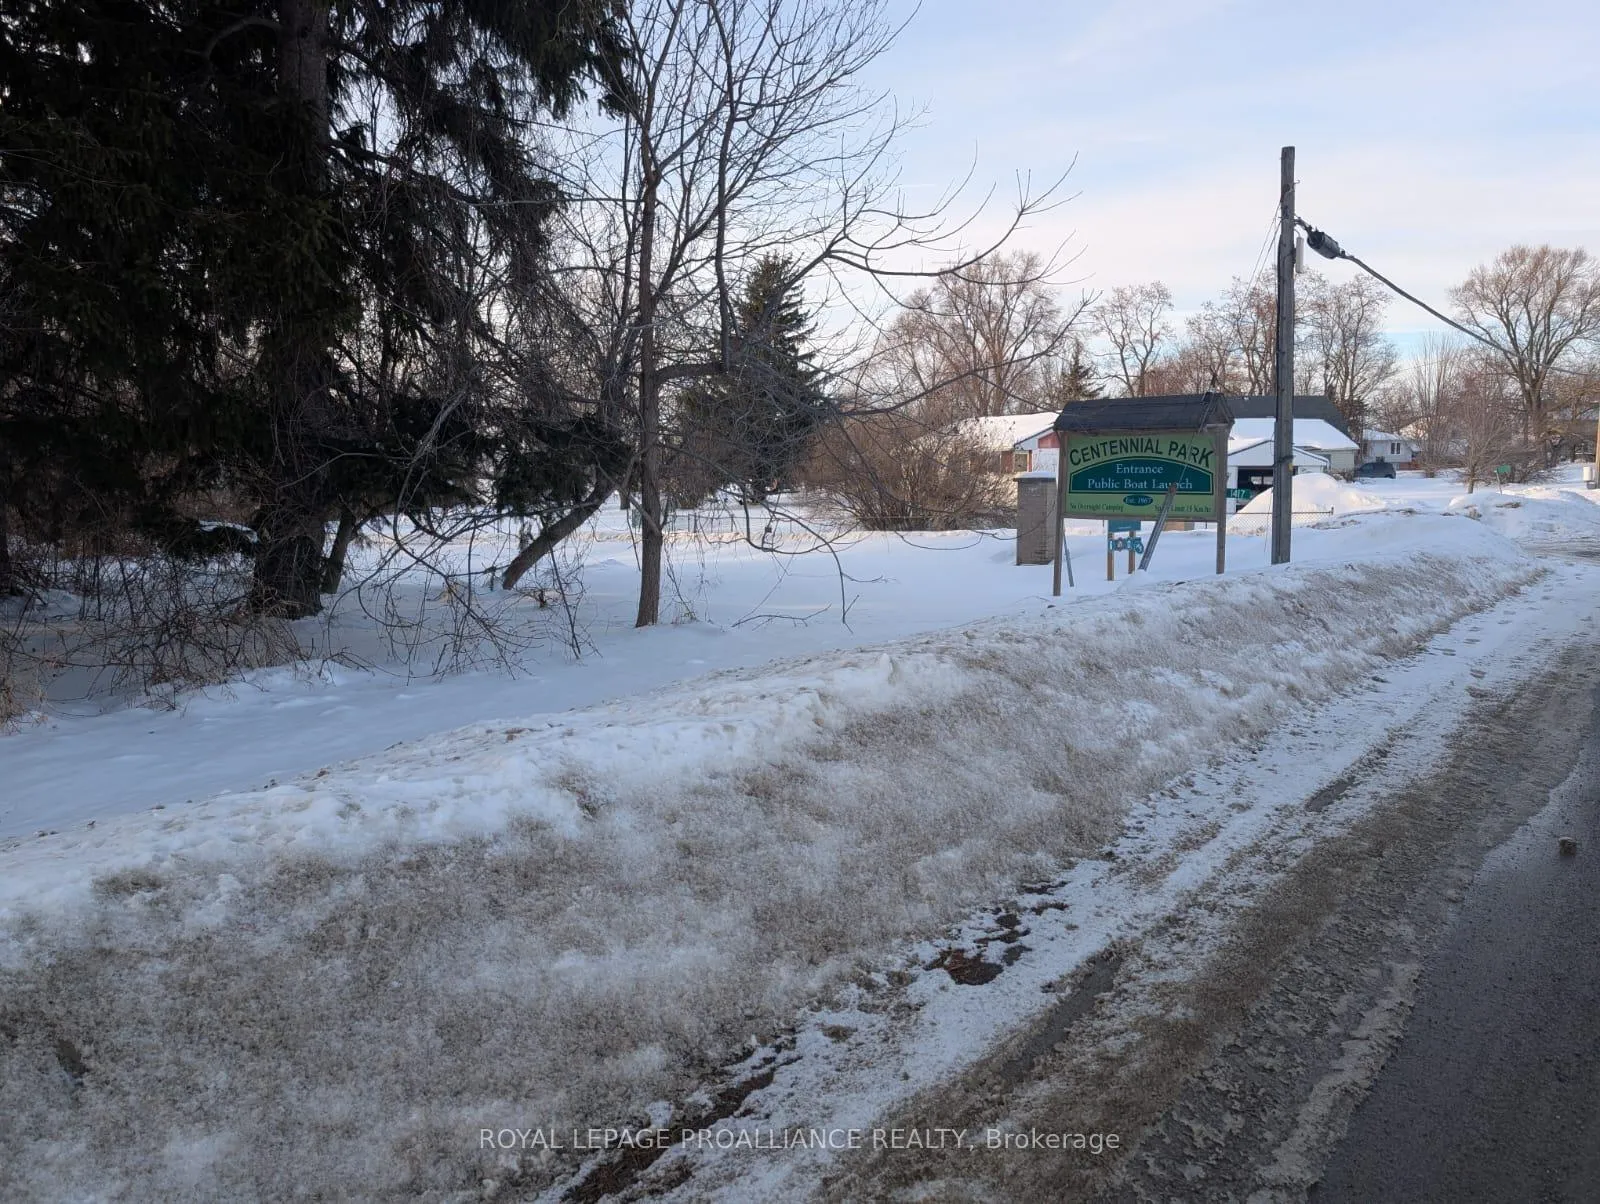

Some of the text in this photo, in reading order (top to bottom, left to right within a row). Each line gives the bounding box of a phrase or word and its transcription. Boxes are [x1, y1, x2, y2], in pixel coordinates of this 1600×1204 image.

[1069, 438, 1214, 468] CENTENNIAL PARK
[1116, 463, 1164, 474] Entrance
[1087, 478, 1120, 489] Public
[1124, 479, 1148, 489] Boat
